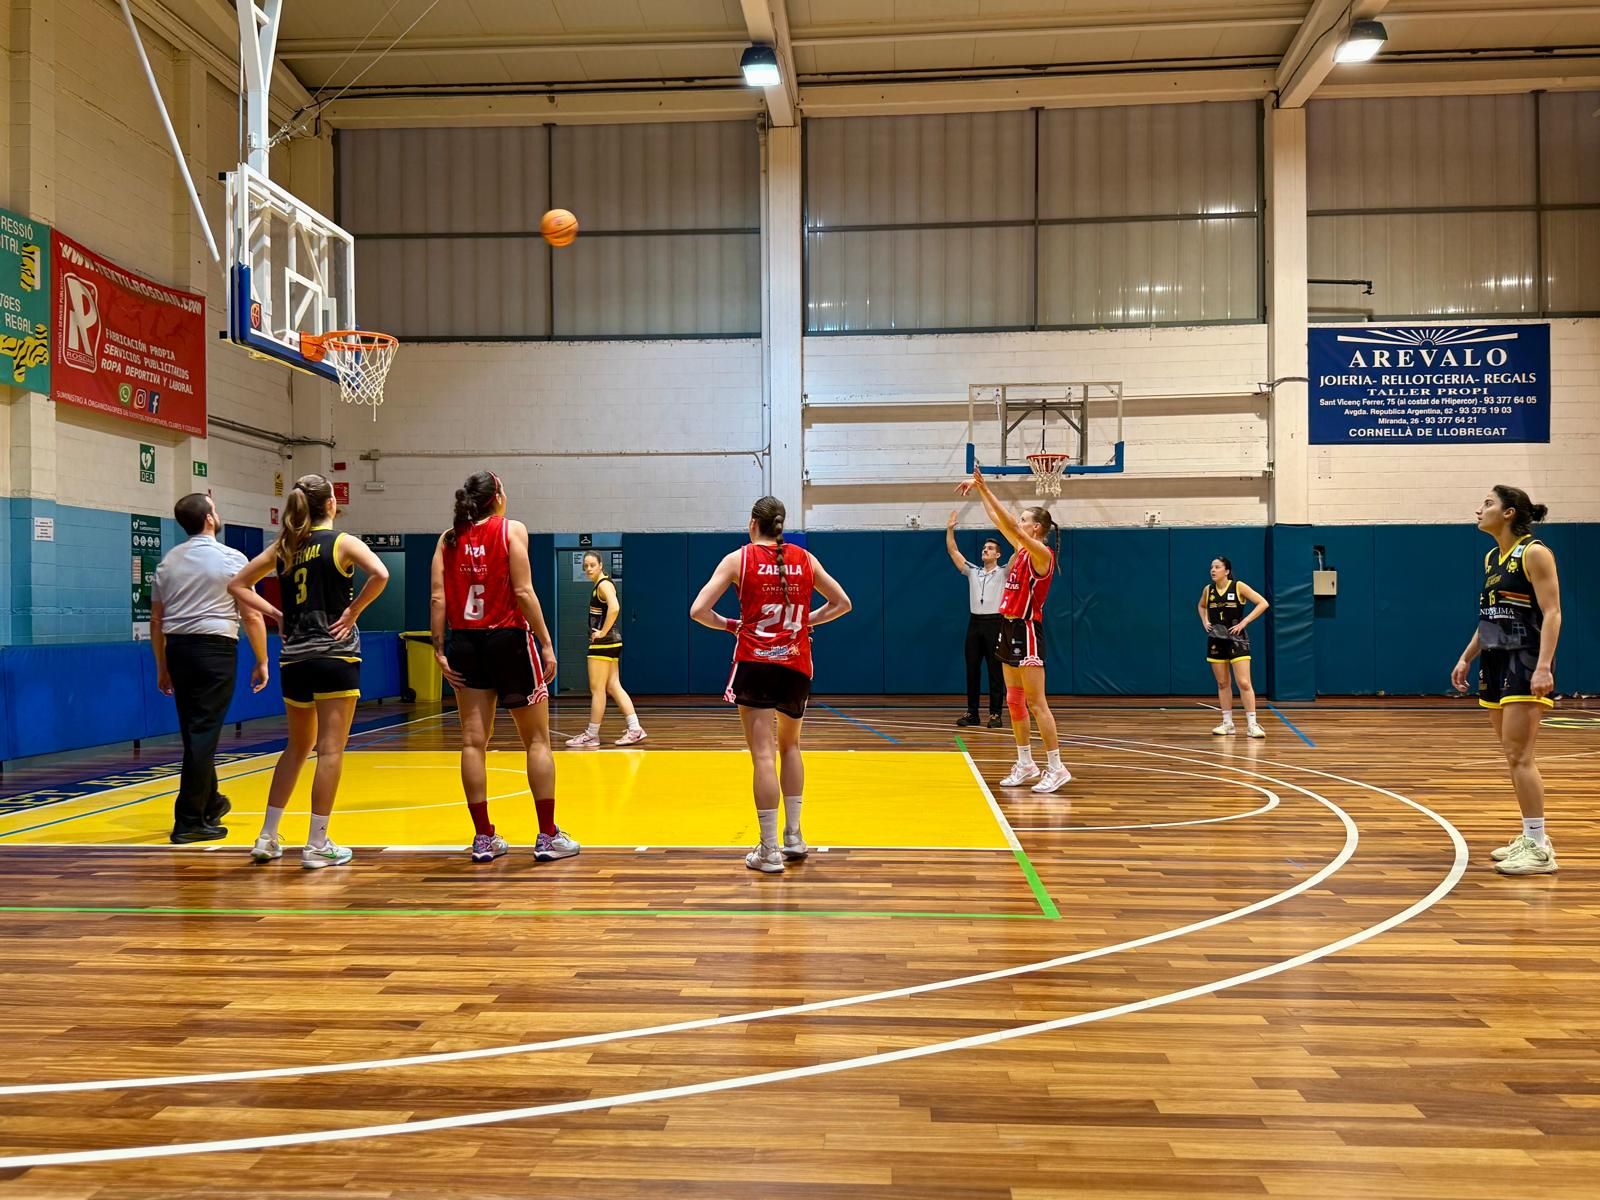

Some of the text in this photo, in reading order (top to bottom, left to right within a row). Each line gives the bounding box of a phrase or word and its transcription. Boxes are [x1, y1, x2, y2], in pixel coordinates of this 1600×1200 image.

[4, 312, 34, 334] REGAL
[103, 343, 141, 364] SERVICIOS
[105, 328, 176, 361] FABRICACIÓN PROPIA
[1348, 348, 1507, 367] AREVALO
[101, 358, 194, 395] ROPA DEPORTIVA Y LABORAL
[1320, 373, 1536, 387] JOIERIA- RELLOTGERIA- REGALS
[1320, 398, 1336, 406] Sant
[1483, 396, 1494, 404] 93
[1497, 396, 1511, 404] 377
[1513, 396, 1524, 404] 64
[1526, 396, 1537, 404] 05
[1367, 387, 1488, 396] TALLER PROPI
[1370, 408, 1405, 416] Republica
[1459, 406, 1470, 414] 93
[1471, 406, 1487, 414] 375
[1490, 406, 1499, 414] 19
[1501, 406, 1512, 414] 03
[1378, 417, 1409, 425] Miranda,
[1349, 426, 1507, 437] CORNELLÀ DE LLOBREGAT
[142, 472, 154, 484] DEA
[294, 567, 308, 605] 3
[464, 584, 485, 620] 6
[755, 603, 804, 639] 24
